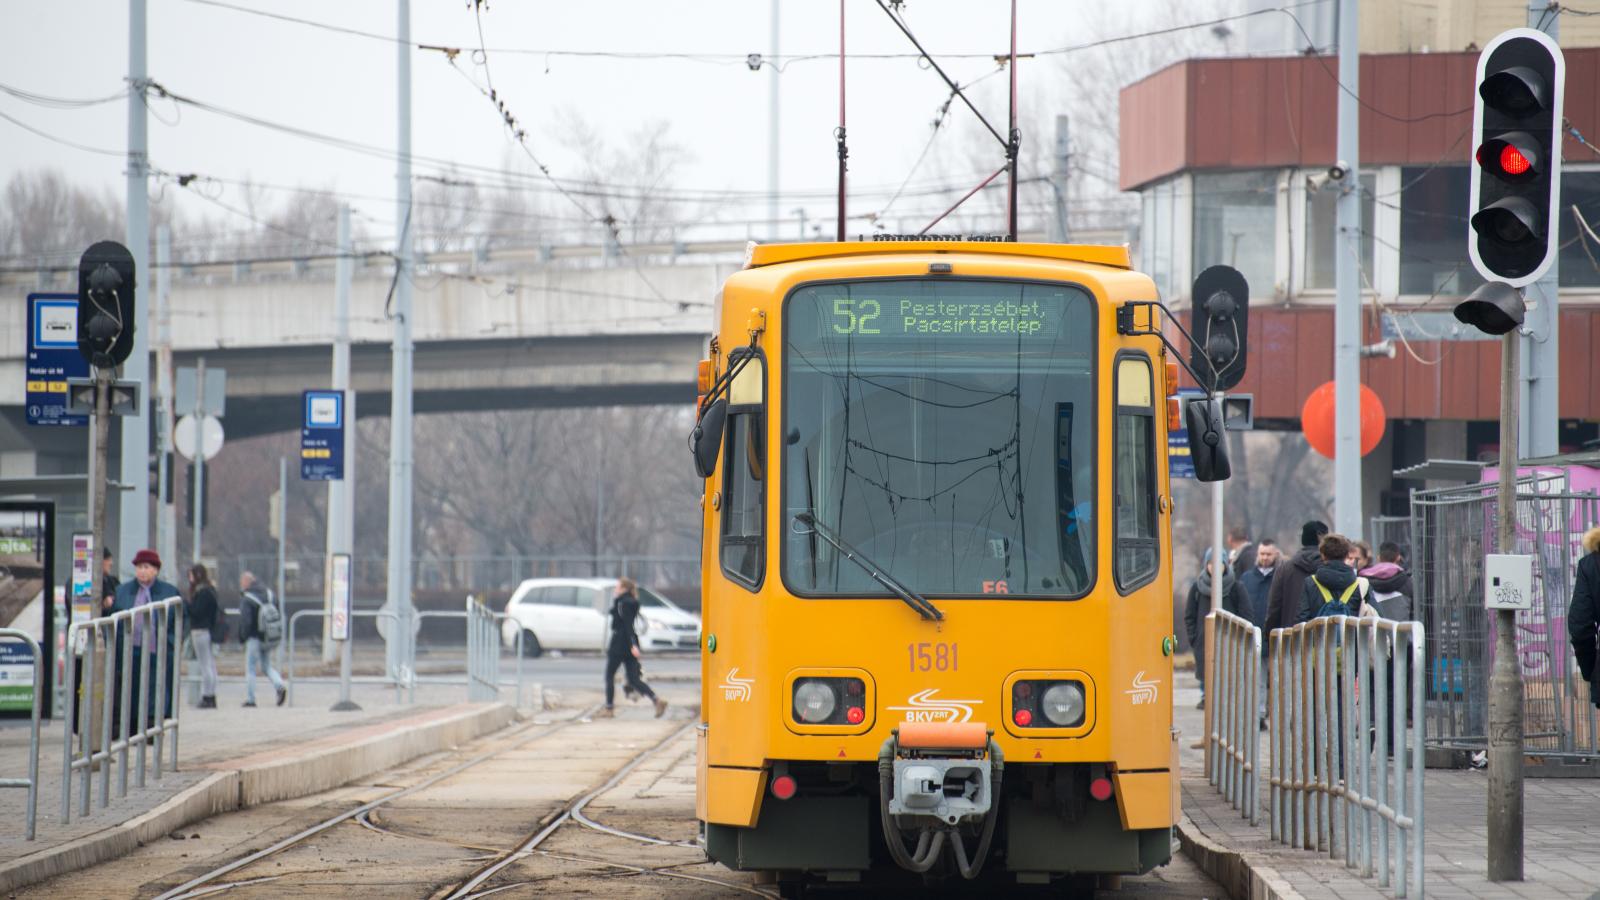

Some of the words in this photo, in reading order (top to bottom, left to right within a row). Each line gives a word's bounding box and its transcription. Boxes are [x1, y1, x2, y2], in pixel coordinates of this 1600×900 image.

[834, 300, 881, 334] 52
[900, 300, 1045, 318] Pesterzsébet,
[904, 317, 1041, 335] Pacsirtatelep
[908, 643, 958, 672] 1581
